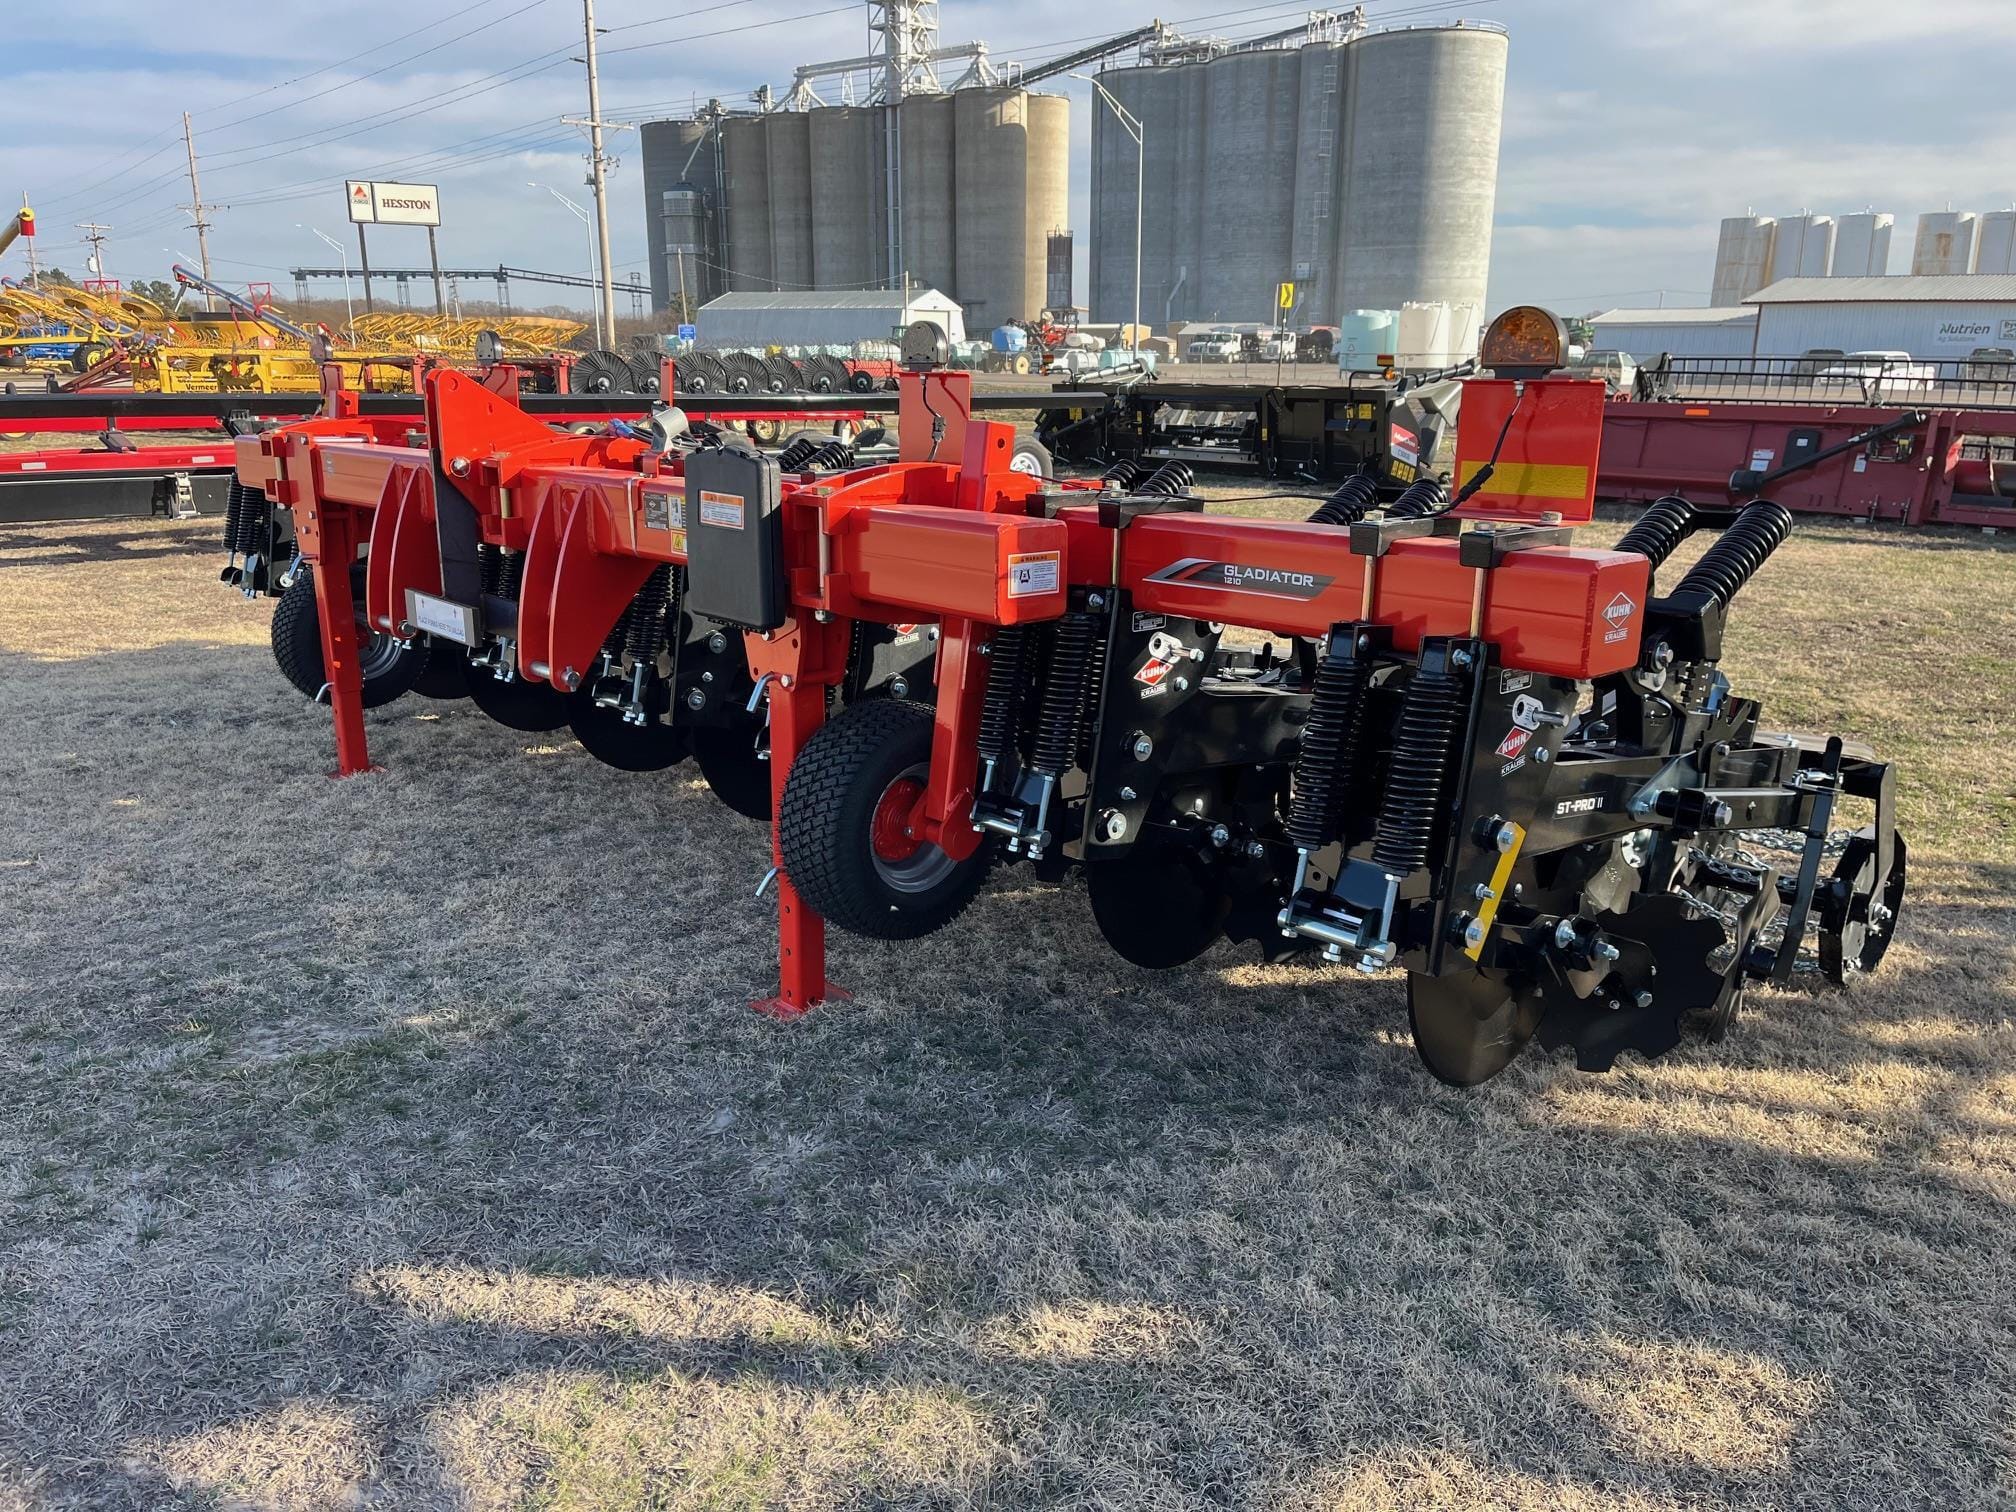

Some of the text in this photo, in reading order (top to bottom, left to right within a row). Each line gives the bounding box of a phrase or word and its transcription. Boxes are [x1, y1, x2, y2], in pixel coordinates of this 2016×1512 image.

[382, 198, 431, 210] HESSTON
[1940, 322, 1991, 335] Nutrien
[186, 383, 218, 391] Vermeer
[1223, 576, 1242, 586] 1210
[1224, 564, 1314, 587] GLADIATOR
[1607, 603, 1631, 619] KUHN
[1604, 629, 1628, 641] KRAUSE
[1140, 664, 1168, 680] KUHN
[1140, 683, 1167, 699] KRAUSE
[1501, 732, 1528, 754] KUHN
[1501, 756, 1527, 776] KRAUSE
[1556, 797, 1596, 815] ST-PRO
